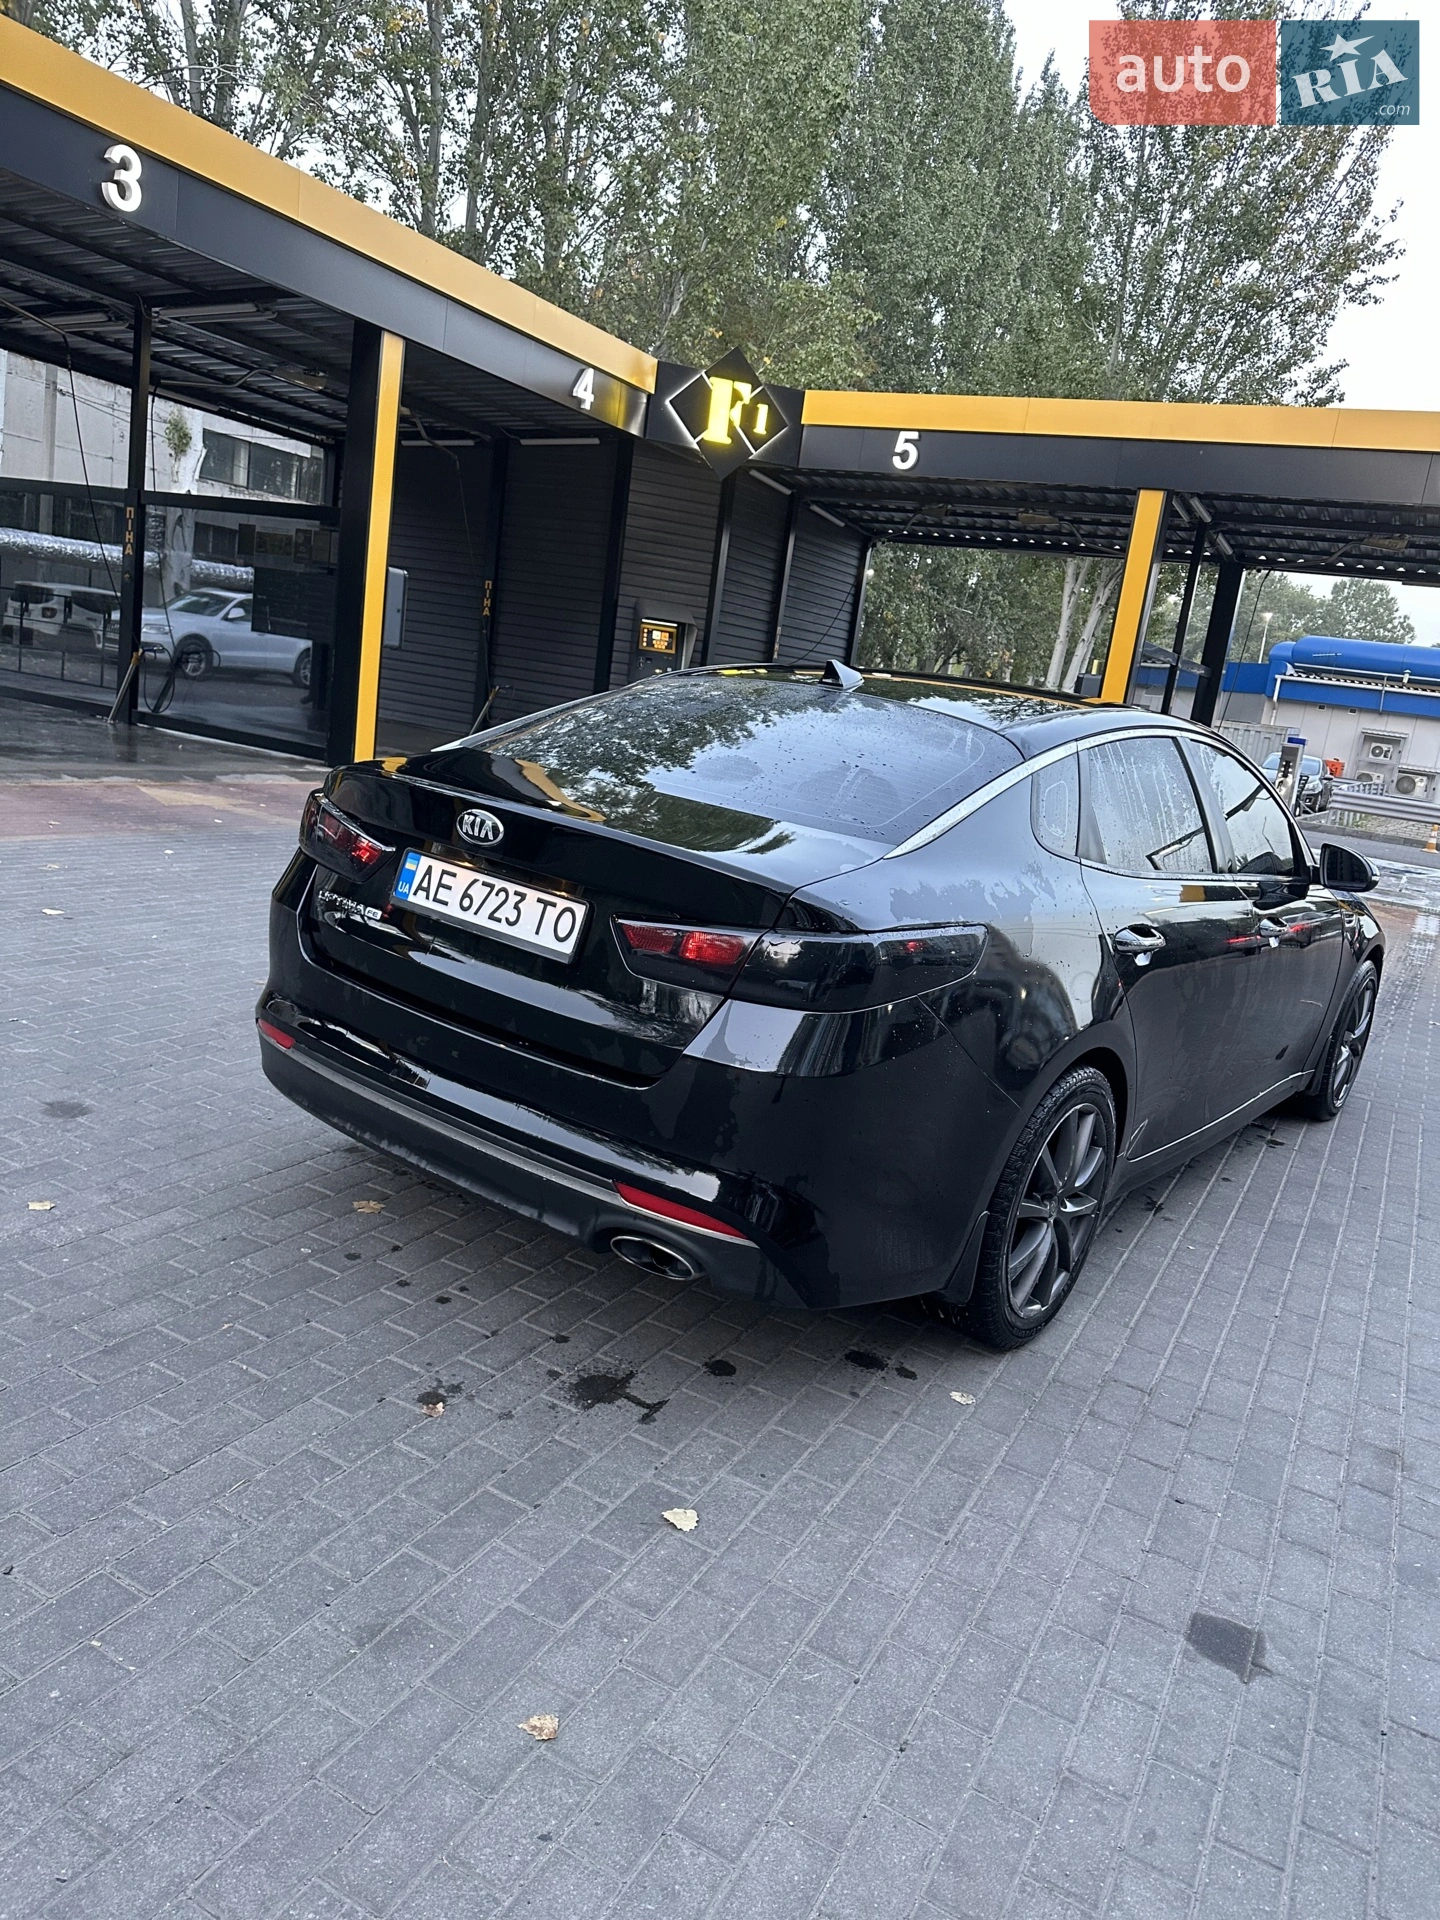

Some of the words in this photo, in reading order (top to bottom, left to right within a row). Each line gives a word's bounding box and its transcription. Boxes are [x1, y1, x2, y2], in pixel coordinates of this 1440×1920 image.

[101, 144, 142, 212] 3
[572, 367, 595, 410] 4
[892, 430, 919, 470] 5
[124, 506, 135, 556] ПІНА
[482, 580, 493, 616] ПІНА
[462, 814, 495, 841] KIA
[397, 881, 410, 895] UA
[412, 864, 458, 907] AE
[458, 878, 528, 927] 6723
[535, 897, 577, 943] TO
